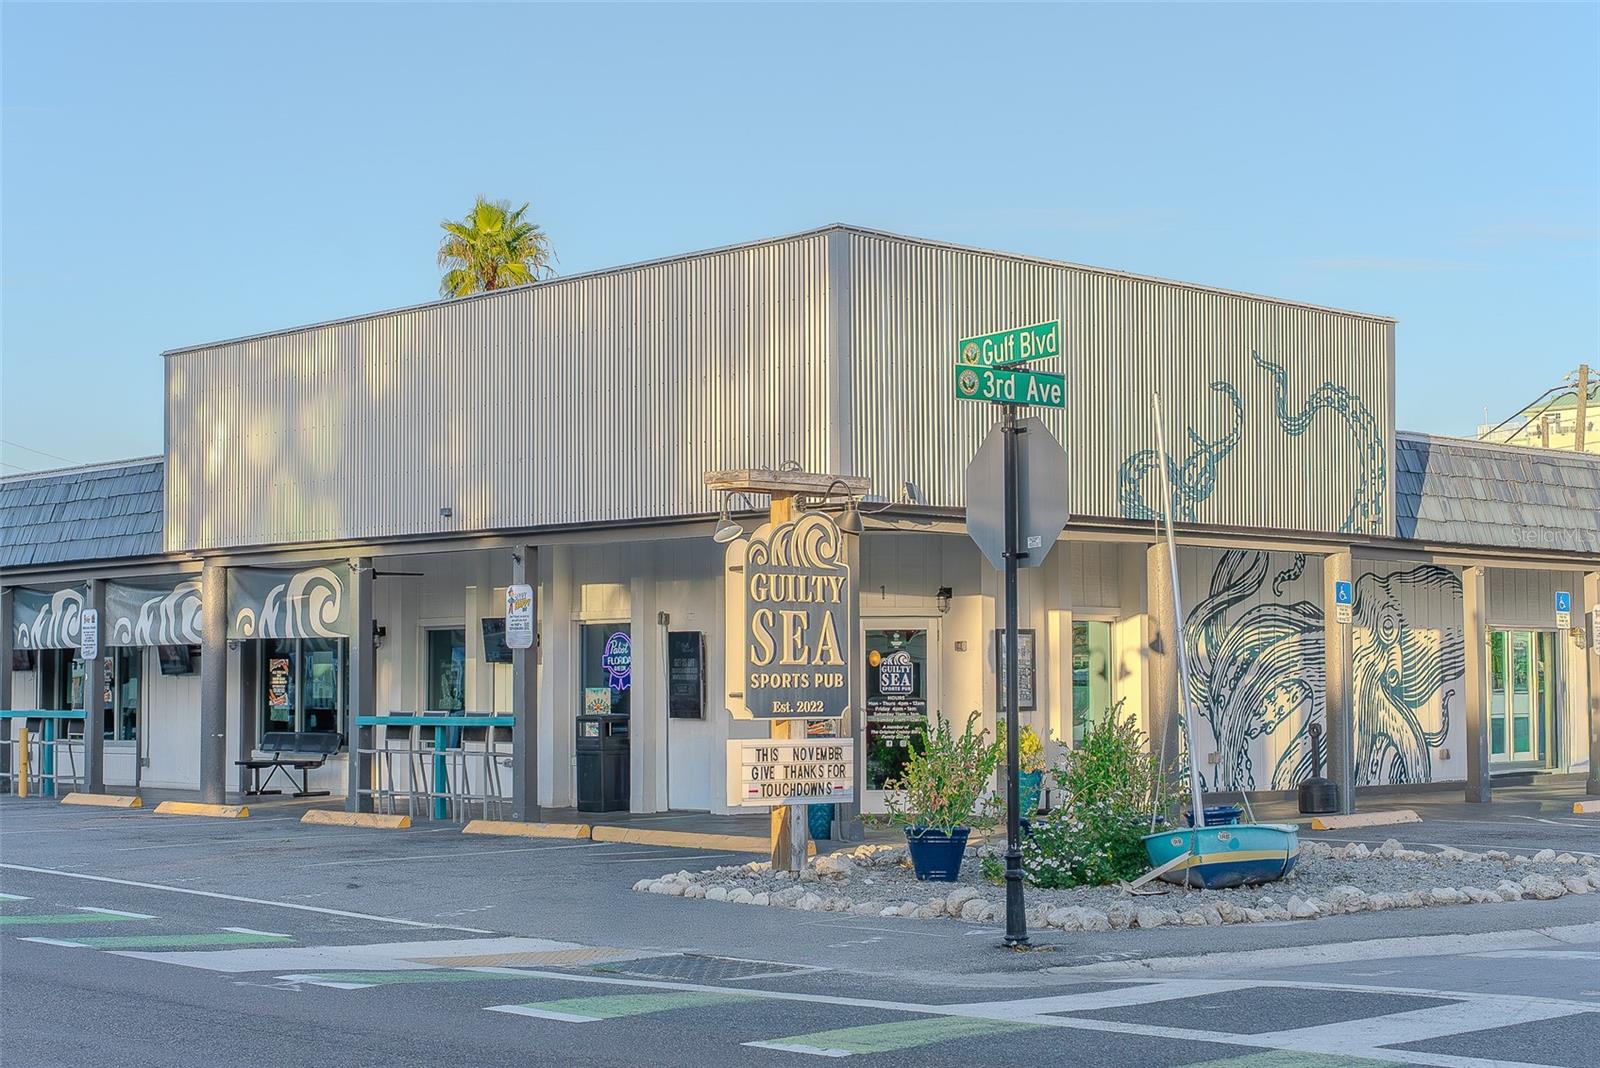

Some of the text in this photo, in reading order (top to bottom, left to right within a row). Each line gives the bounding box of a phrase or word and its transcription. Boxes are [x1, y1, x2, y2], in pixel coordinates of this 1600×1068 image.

[983, 326, 1056, 365] Gulf Blvd
[983, 371, 1061, 404] 3rd Ave
[750, 573, 845, 603] GUILTY
[751, 608, 845, 666] SEA
[881, 665, 911, 673] GUILTY
[751, 673, 844, 689] SPORTS PUB
[881, 673, 911, 687] SEA
[772, 700, 824, 713] Est. 2022
[756, 747, 842, 761] THIS NOVEMBER
[752, 764, 845, 780] GIVE THANKS FOR
[761, 782, 831, 797] TOUCHDOWNS
